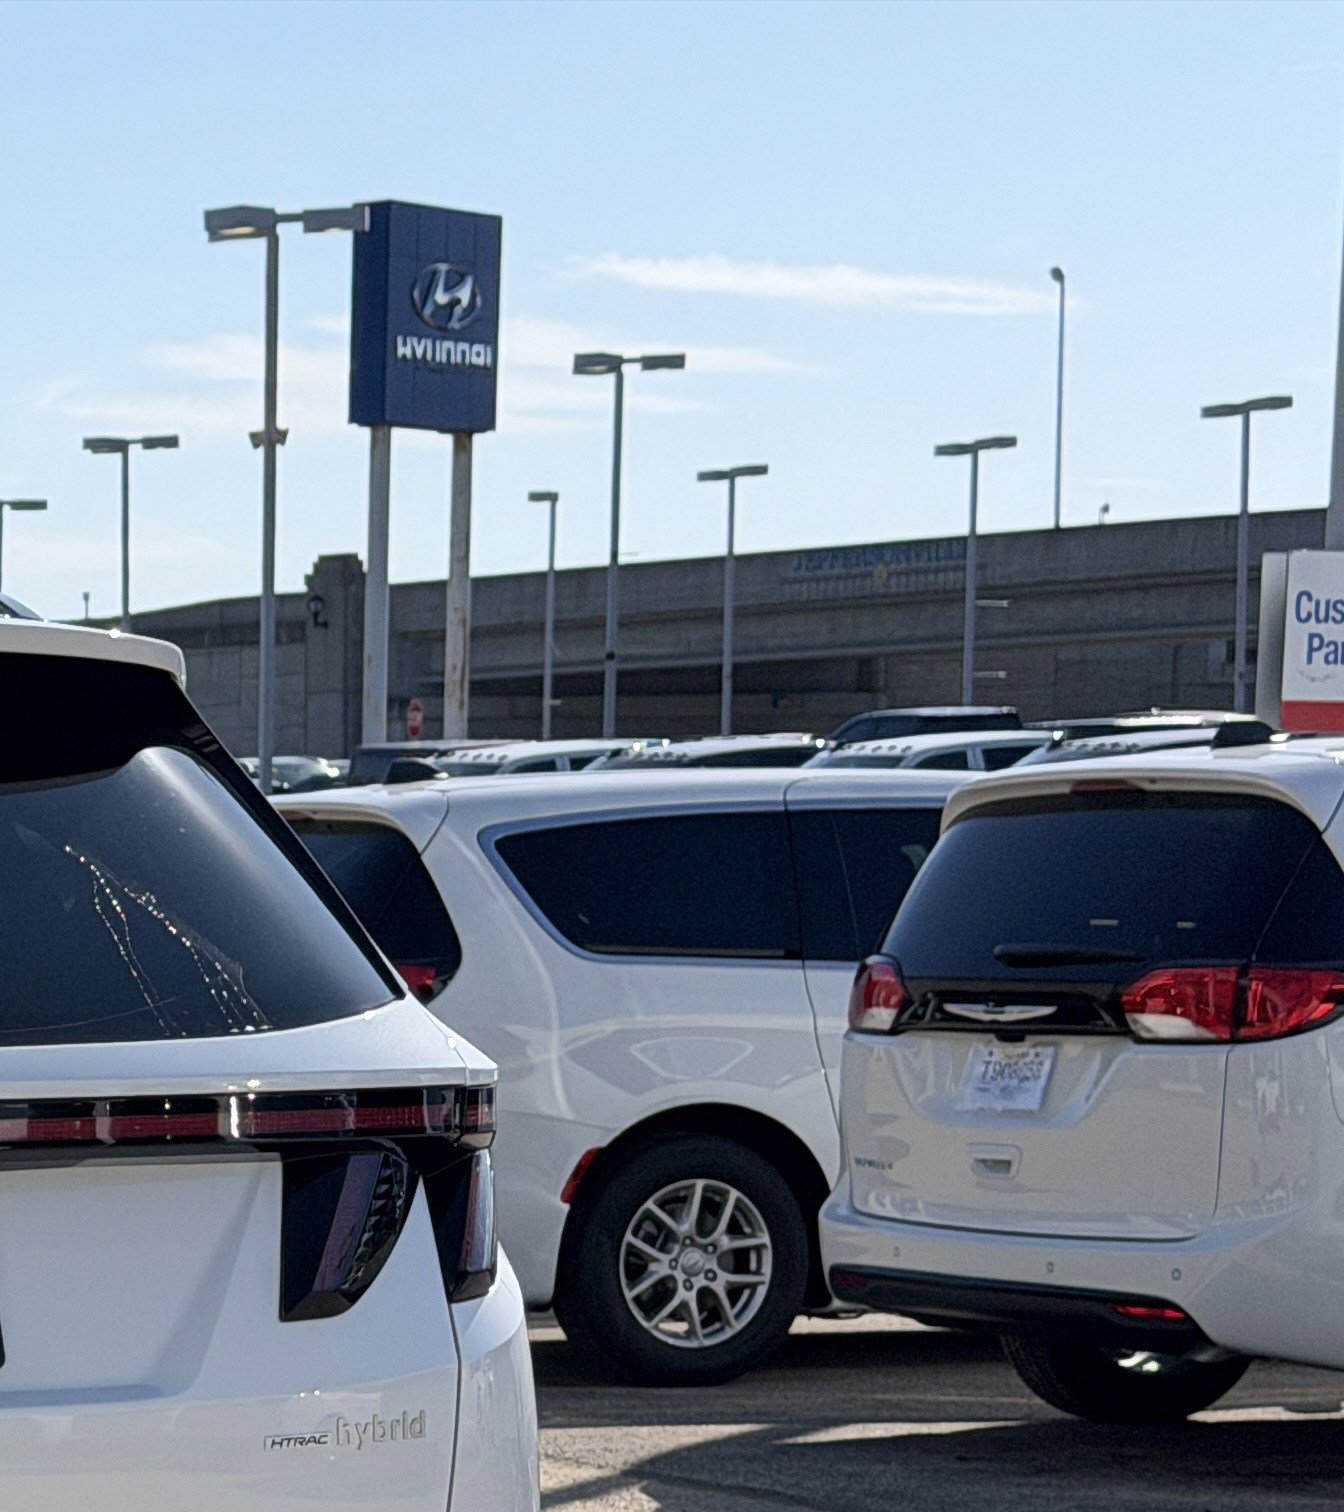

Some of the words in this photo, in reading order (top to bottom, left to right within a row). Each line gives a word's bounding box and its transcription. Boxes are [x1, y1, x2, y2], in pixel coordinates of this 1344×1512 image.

[396, 335, 493, 367] HYUNDAI
[269, 1433, 329, 1450] HTRAC
[335, 1409, 427, 1451] hybrid
